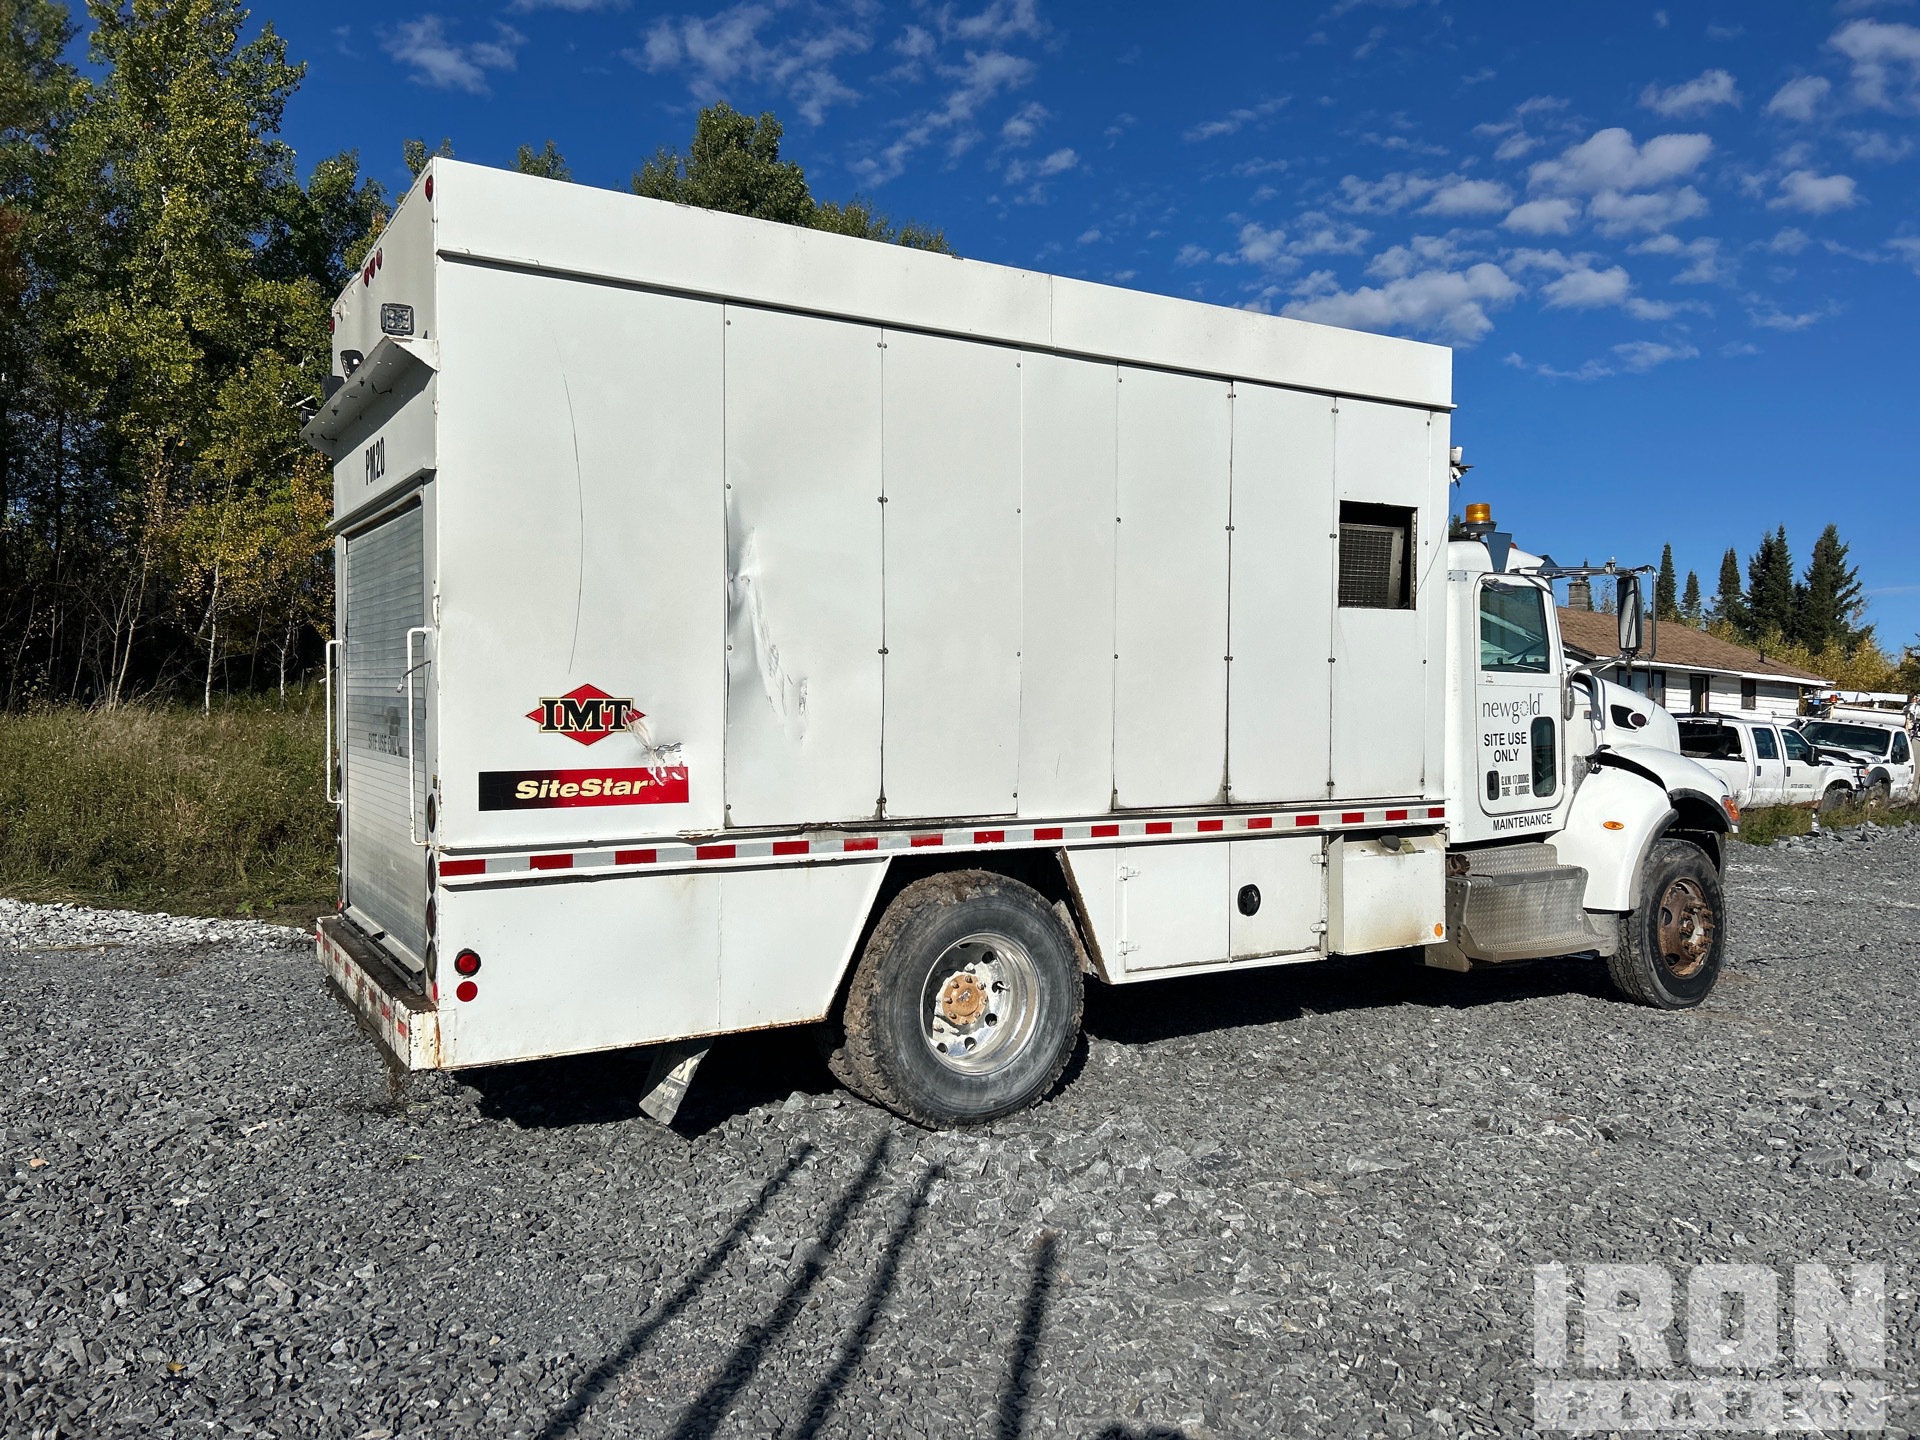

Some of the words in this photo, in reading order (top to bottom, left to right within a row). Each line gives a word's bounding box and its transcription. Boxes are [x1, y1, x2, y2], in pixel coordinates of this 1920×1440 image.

[365, 436, 386, 486] PM20
[540, 698, 633, 732] IMT
[1482, 692, 1541, 724] newgold
[1483, 733, 1506, 747] SITE
[1507, 731, 1527, 745] USE
[1494, 748, 1519, 763] ONLY
[1492, 812, 1552, 831] MAINTENANCE
